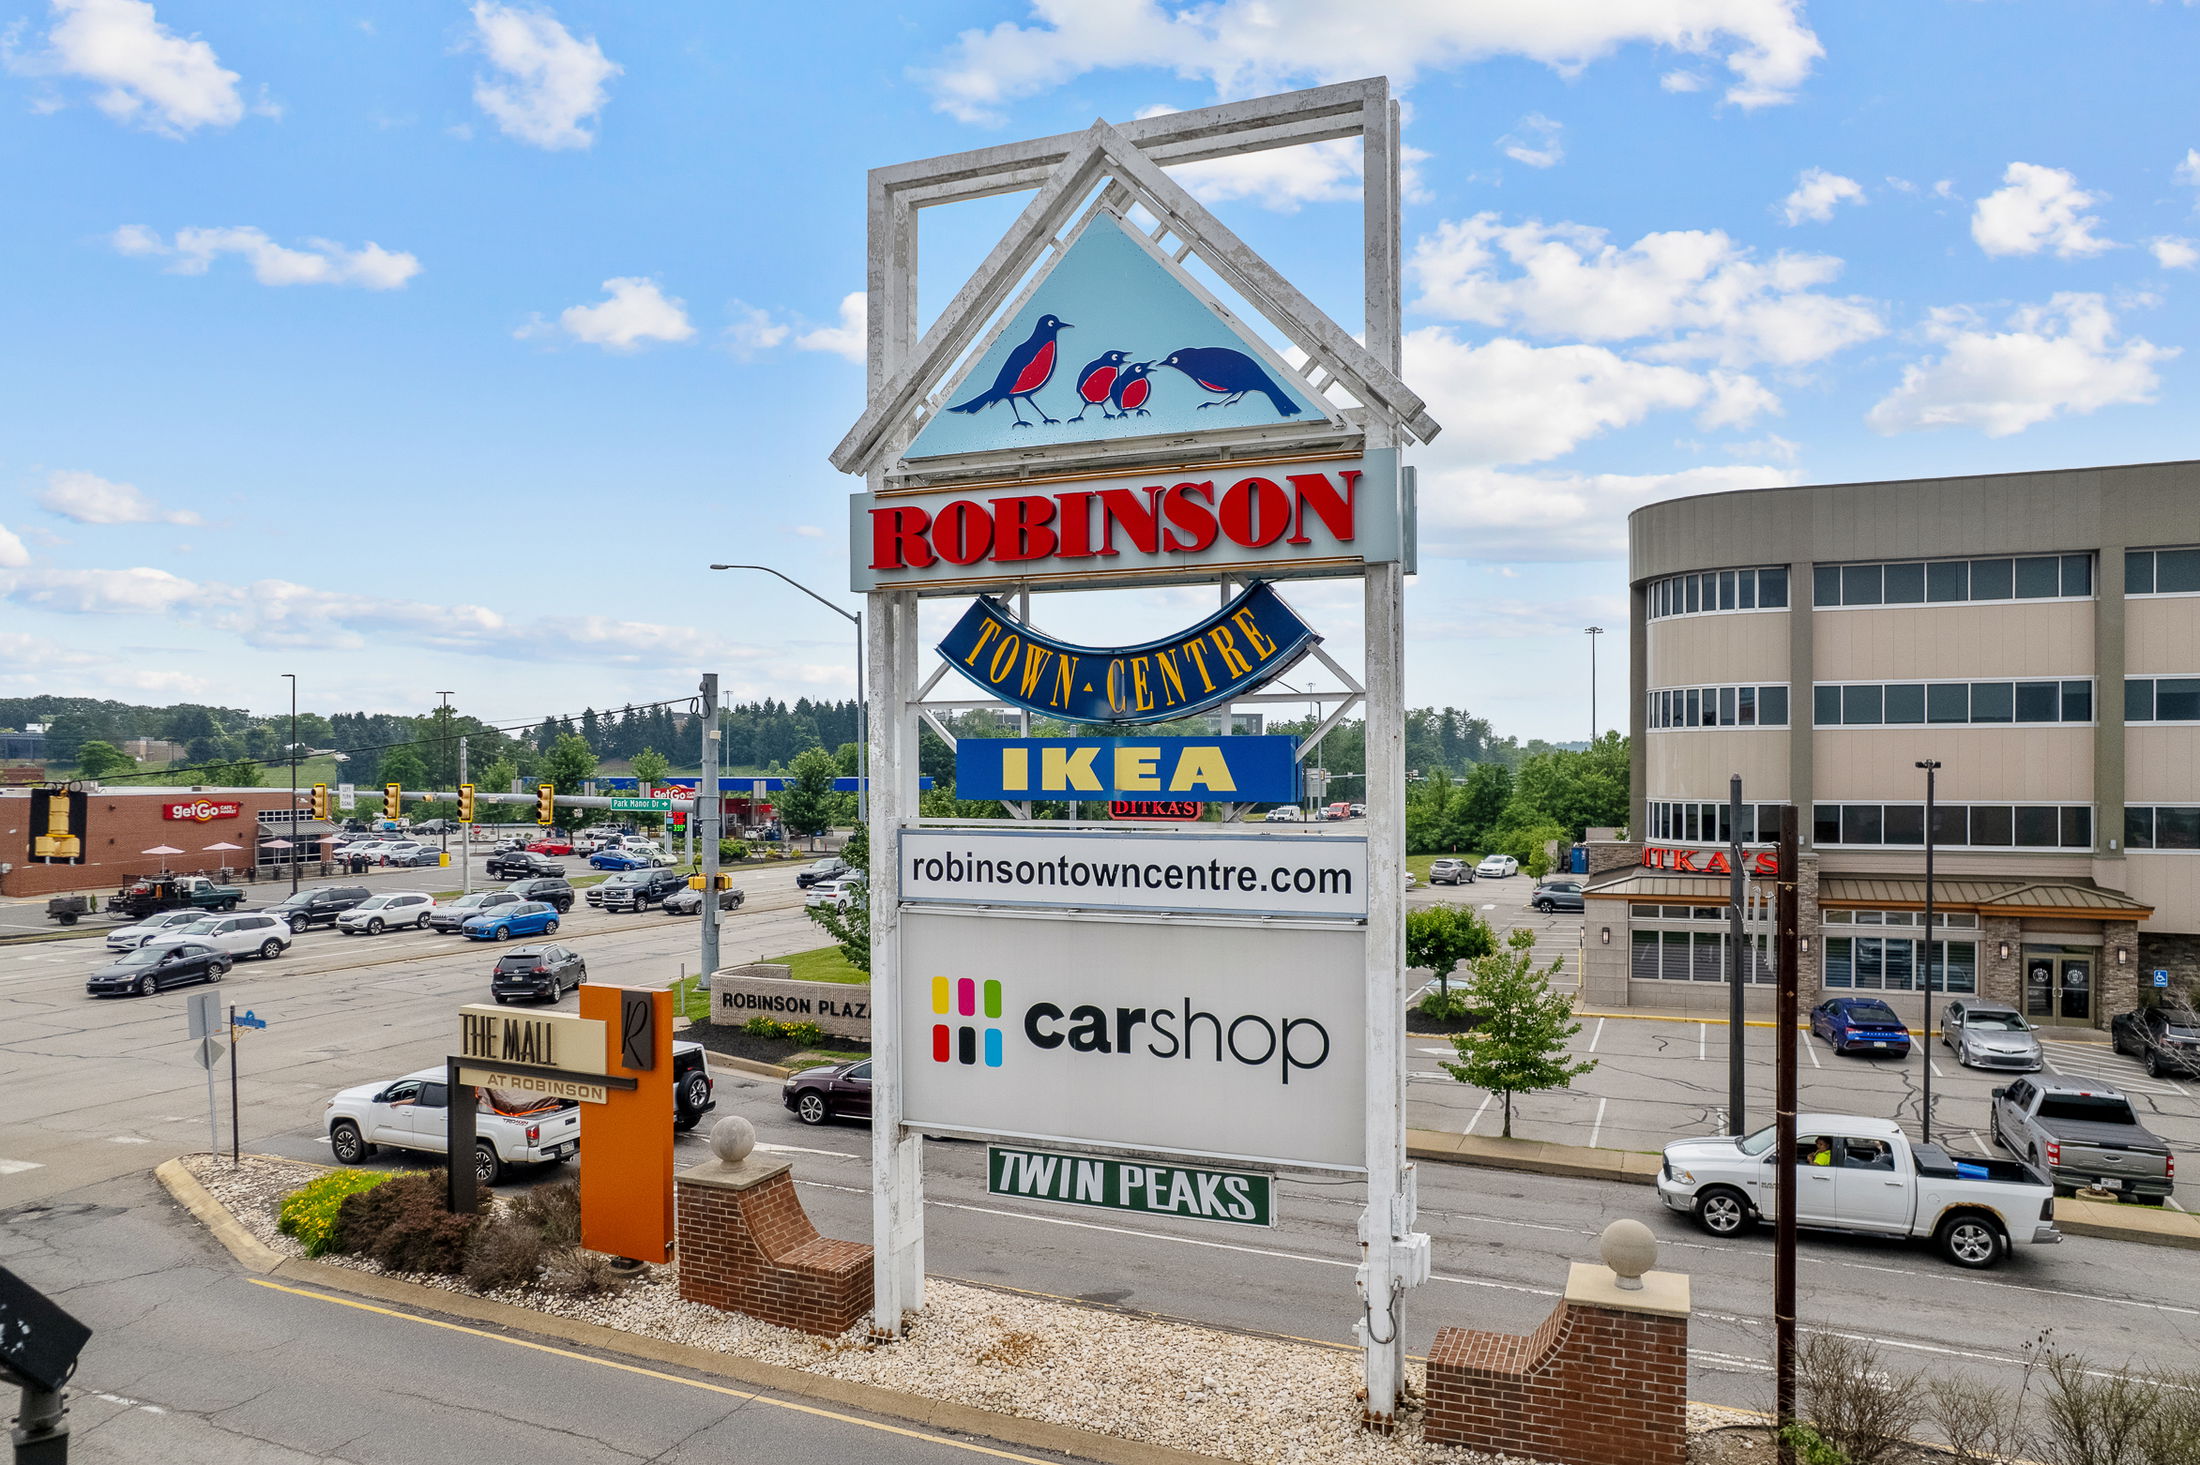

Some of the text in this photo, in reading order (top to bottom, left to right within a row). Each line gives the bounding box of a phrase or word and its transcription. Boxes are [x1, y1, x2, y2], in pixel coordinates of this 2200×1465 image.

[868, 470, 1363, 570] ROBINSON
[964, 606, 1278, 714] TOWN CENTRE
[1002, 746, 1238, 792] IKEA
[172, 803, 219, 819] getGo
[613, 799, 659, 808] Park Manor Dr
[913, 851, 1352, 895] robinsontowncentre.com
[1641, 847, 1778, 875] ITKA'S
[722, 992, 872, 1019] ROBINSON PLAZ
[458, 1013, 557, 1067] THE MALL
[1023, 996, 1331, 1085] carshop
[487, 1073, 603, 1100] AT ROBINSON
[998, 1151, 1257, 1220] TWIN PEAKS
